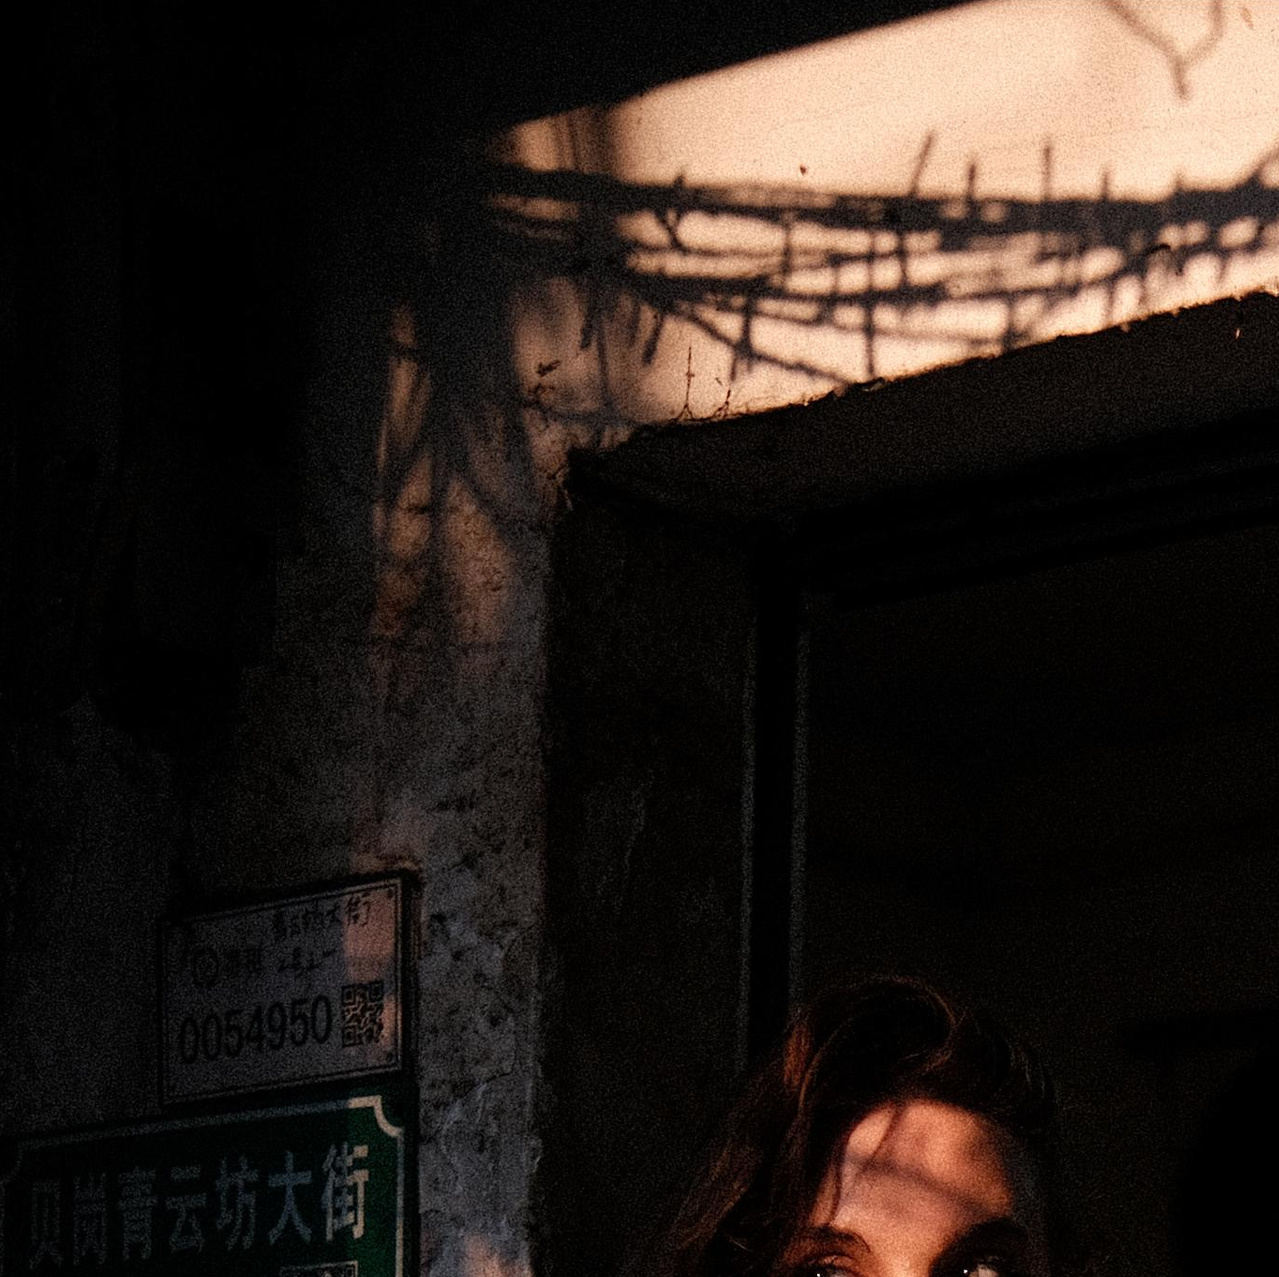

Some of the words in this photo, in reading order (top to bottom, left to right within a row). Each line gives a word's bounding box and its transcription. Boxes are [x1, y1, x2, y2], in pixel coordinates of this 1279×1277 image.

[178, 995, 333, 1065] 0054950
[28, 1142, 370, 1271] 贝岗青云坊大街
